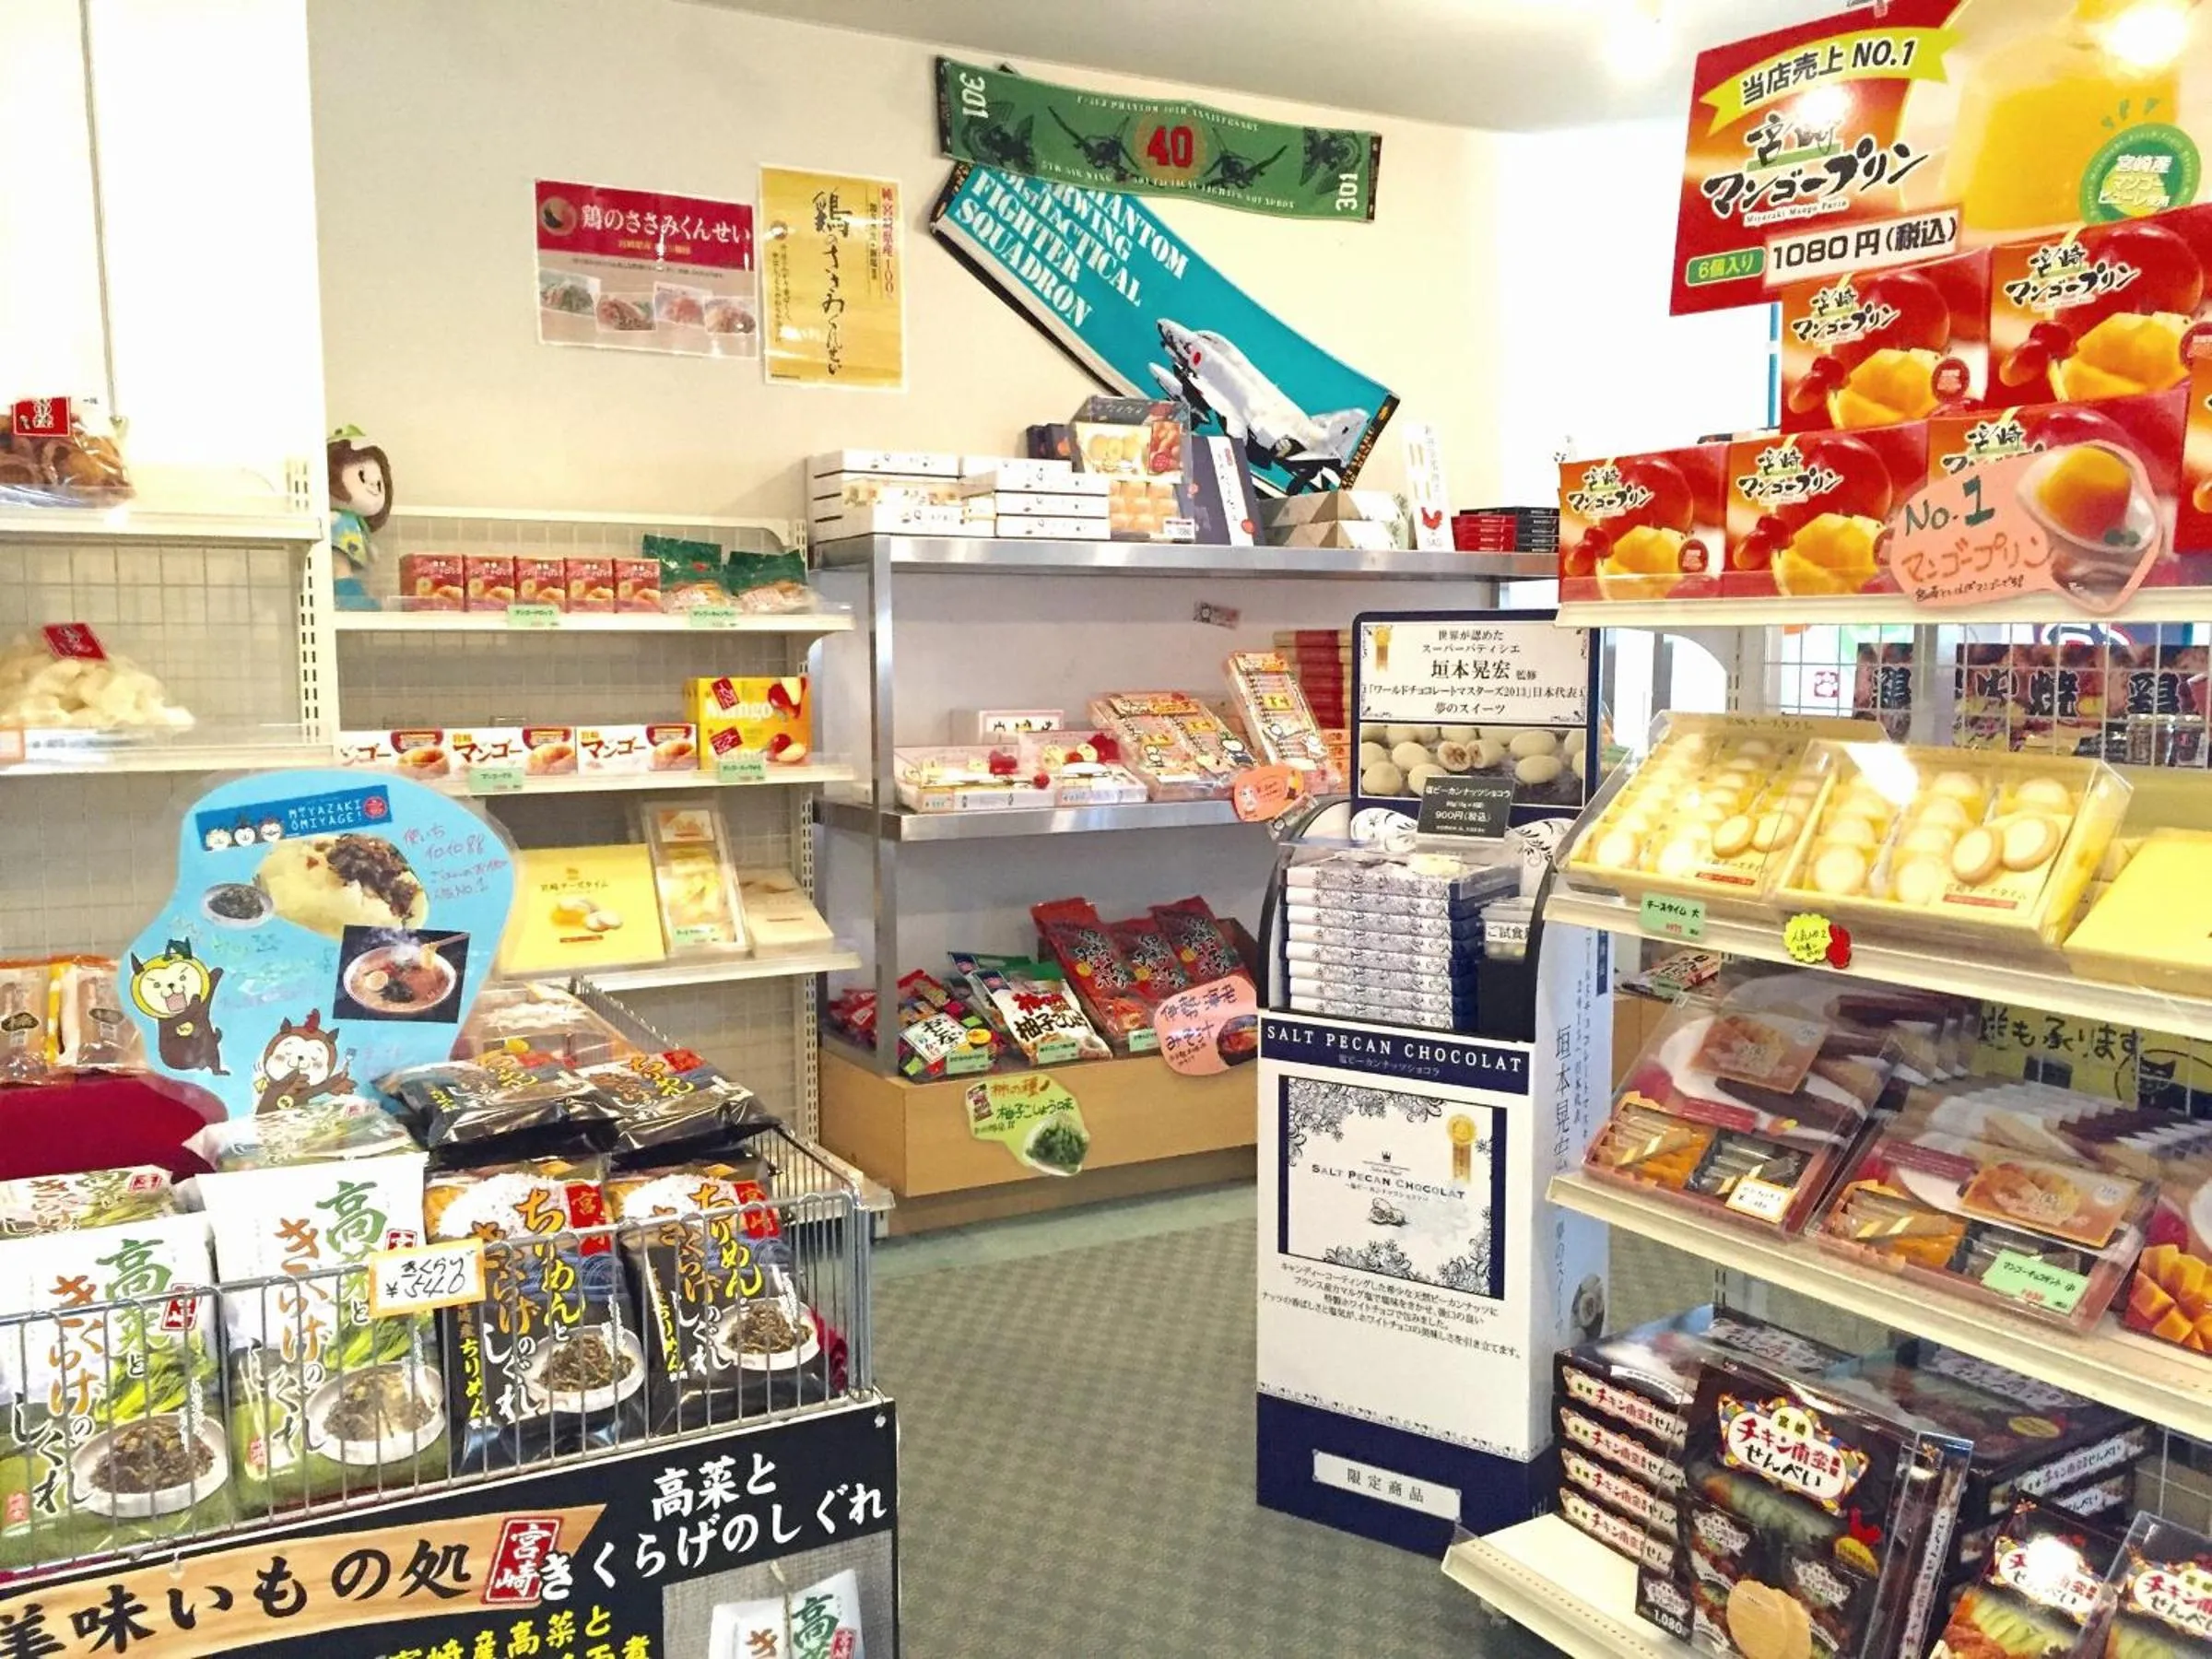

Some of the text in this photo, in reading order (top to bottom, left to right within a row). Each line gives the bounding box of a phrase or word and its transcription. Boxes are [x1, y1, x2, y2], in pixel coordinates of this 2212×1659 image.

[1741, 40, 1915, 107] 当店売上 NO.1
[959, 72, 989, 119] 301
[1147, 125, 1194, 168] 40
[1335, 172, 1359, 211] 301
[1704, 137, 1929, 215] マンゴープリン
[582, 204, 751, 244] 鶏のささみくんせい
[971, 171, 1080, 284] FIGHTER
[1086, 191, 1189, 280] ANTOM
[955, 197, 1093, 328] SQUADRON
[1037, 193, 1142, 308] TACTICAL
[1698, 253, 1755, 278] 6個入り
[2030, 247, 2087, 277] 宮崎
[2007, 262, 2140, 304] マンゴープリン
[1793, 303, 1900, 340] マンゴープリン
[1811, 290, 1859, 316] 宮崎
[1758, 449, 1802, 476] 宮崎
[1569, 486, 1654, 513] マンゴープリン
[1738, 467, 1842, 499] マンゴープリン
[1905, 476, 1995, 536] No.1
[1901, 533, 2054, 582] マンゴープリン
[1422, 643, 1522, 655] スーパーパティシエ
[1438, 629, 1505, 641] 世界が認めた
[1430, 658, 1512, 681] 垣本晃宏
[1434, 702, 1506, 716] 夢のスイーツ
[339, 741, 392, 767] ンゴー
[454, 739, 524, 762] マンゴー
[581, 735, 647, 759] マンゴー
[288, 799, 363, 819] MIYAZAKI
[290, 811, 364, 831] OMIYAGE!
[1267, 1025, 1524, 1073] SALT PECAN CHOCOLAT
[1312, 1163, 1344, 1178] SALT
[1347, 1170, 1392, 1187] PECAN
[1395, 1179, 1466, 1200] CHOCOLAT
[1777, 1414, 1807, 1436] 宮崎
[1745, 1444, 1821, 1488] せんべい
[653, 1453, 778, 1524] 高菜と
[1347, 1467, 1424, 1504] 限定商品
[540, 1483, 888, 1602] きくらげのしぐれ
[493, 1524, 557, 1600] 宮崎
[0, 1538, 473, 1659] 美味いもの処
[1653, 1608, 1684, 1634] 1,080
